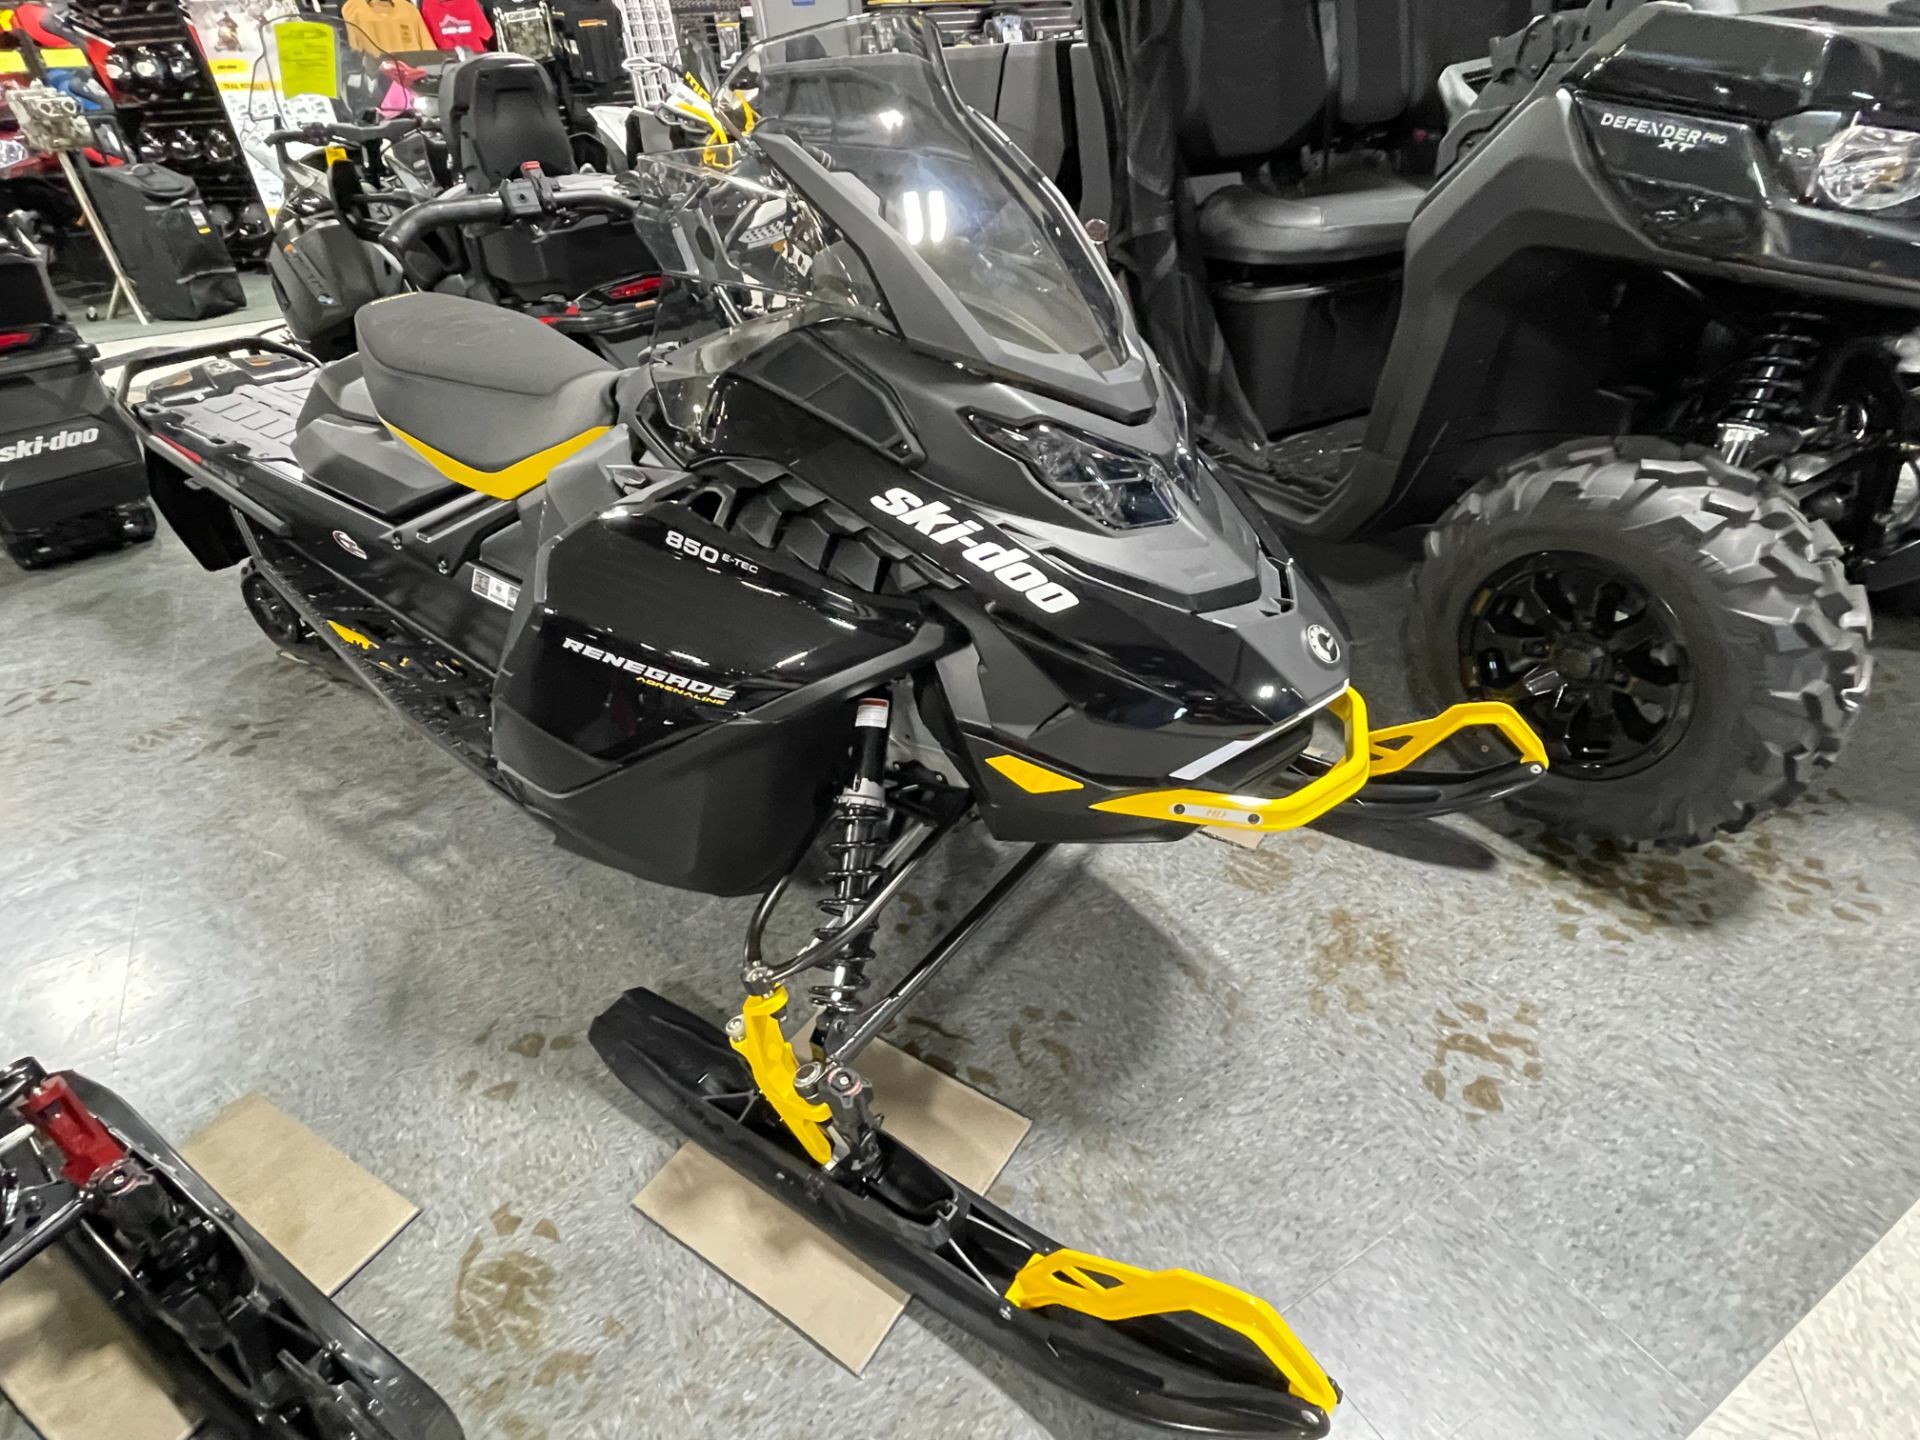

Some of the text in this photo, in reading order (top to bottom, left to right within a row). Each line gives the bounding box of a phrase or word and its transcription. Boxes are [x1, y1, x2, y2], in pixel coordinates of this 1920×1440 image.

[1600, 112, 1728, 144] DEFENDER PRO
[1658, 138, 1696, 152] XT
[0, 427, 99, 462] ski-doo
[665, 529, 759, 574] 850 E-TEC
[870, 487, 1080, 614] ski-doo
[562, 637, 736, 701] RENEGADE
[635, 676, 727, 706] ADRENALINE
